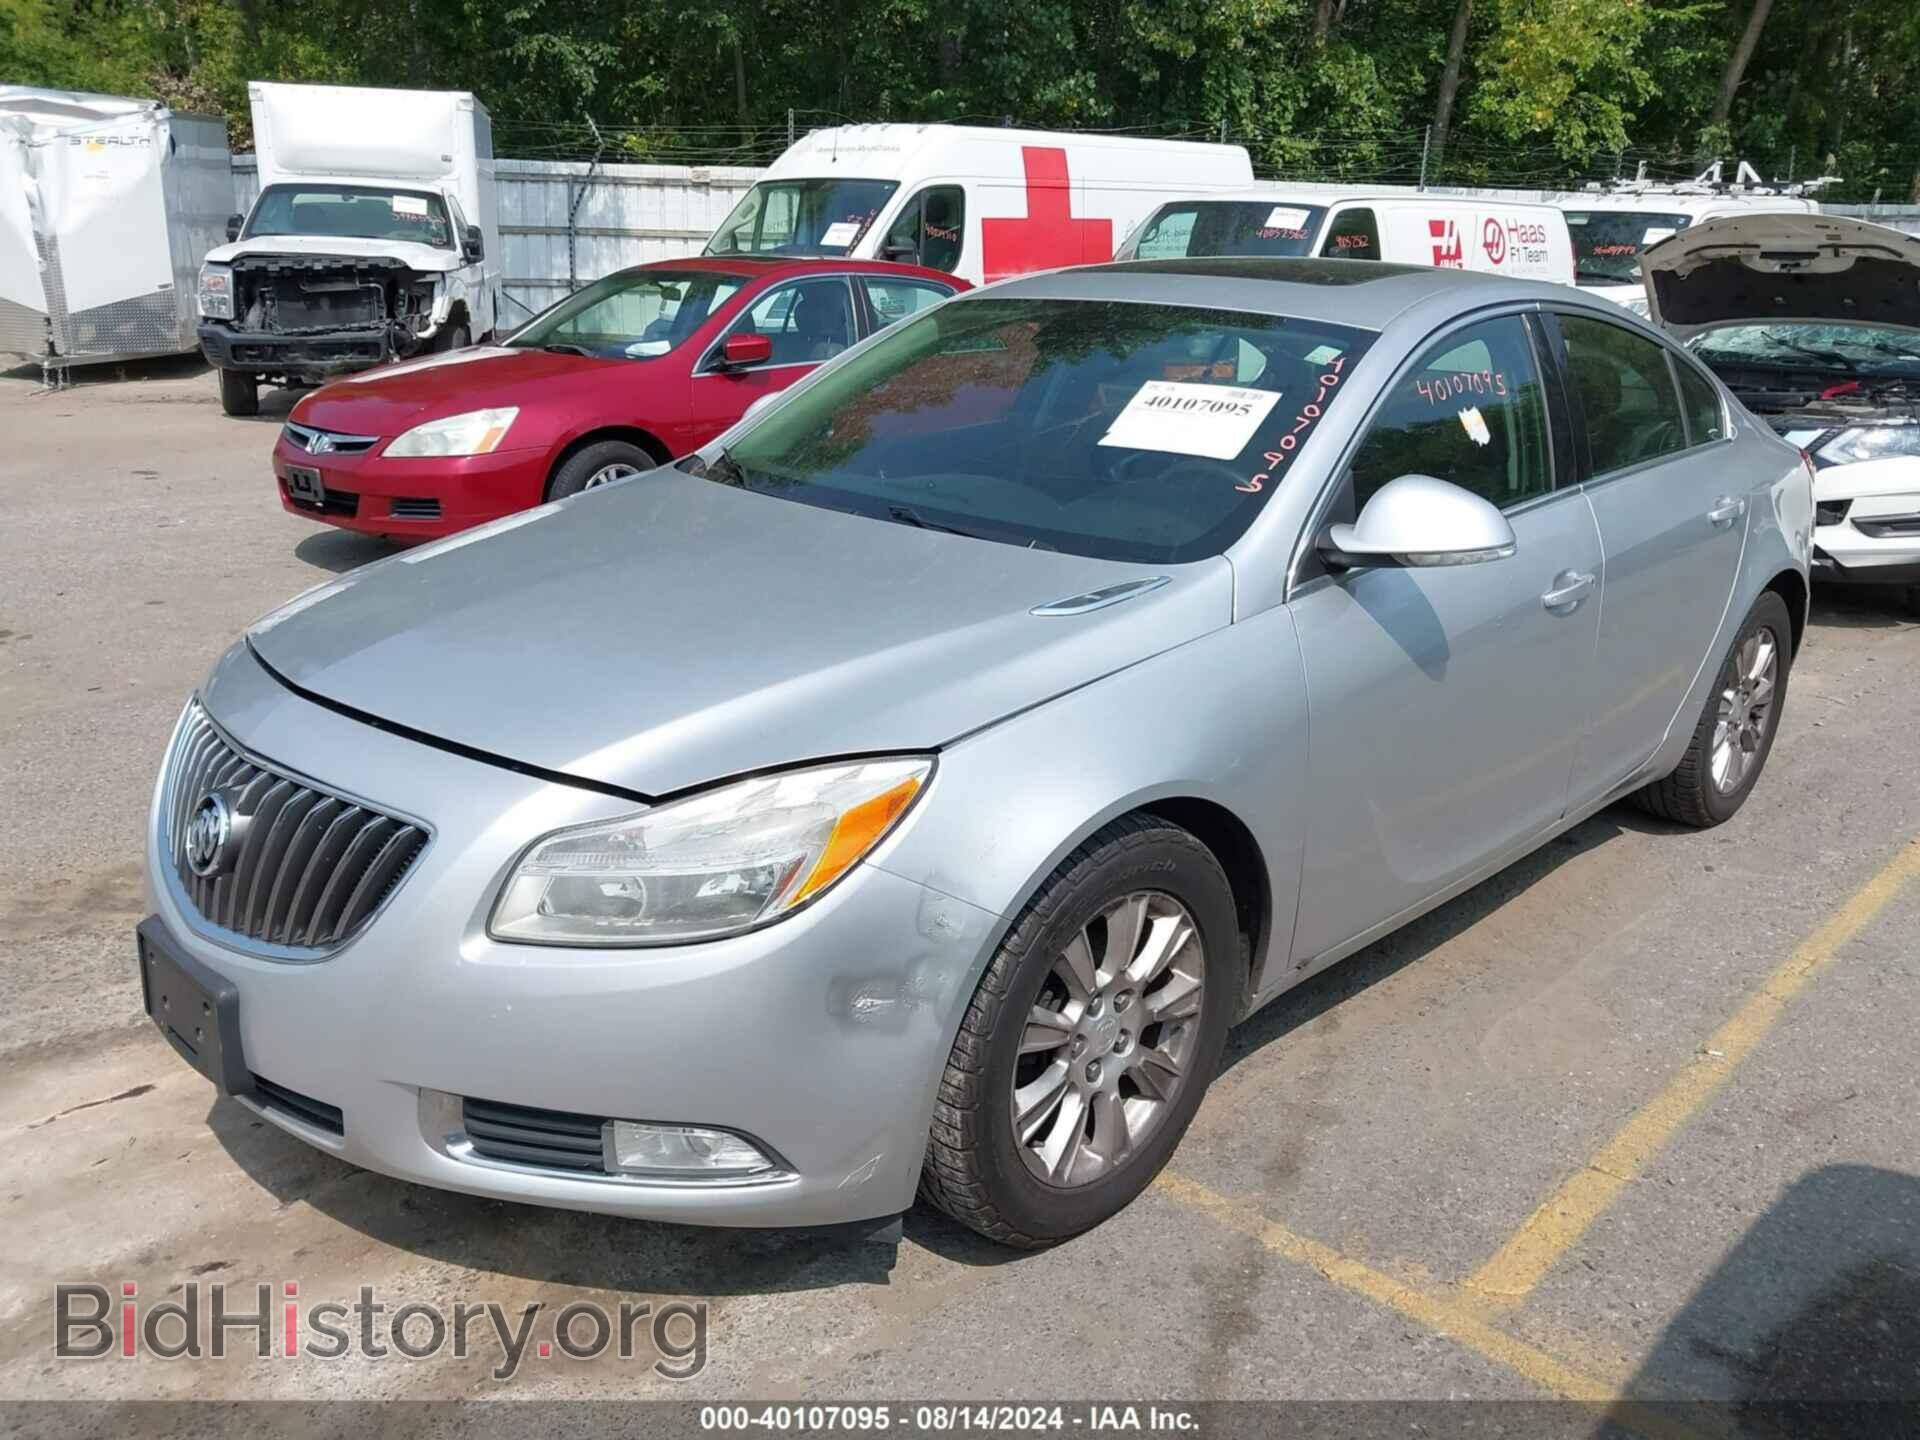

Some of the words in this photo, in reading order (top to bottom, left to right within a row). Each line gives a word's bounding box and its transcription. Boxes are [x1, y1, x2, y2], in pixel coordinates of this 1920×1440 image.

[69, 135, 152, 146] STEALTH
[1505, 217, 1547, 244] Haas
[1510, 246, 1521, 264] F1
[1522, 246, 1549, 264] Team
[1416, 369, 1507, 407] 40107095
[1144, 395, 1253, 416] 40107095
[1234, 357, 1346, 493] 40107095
